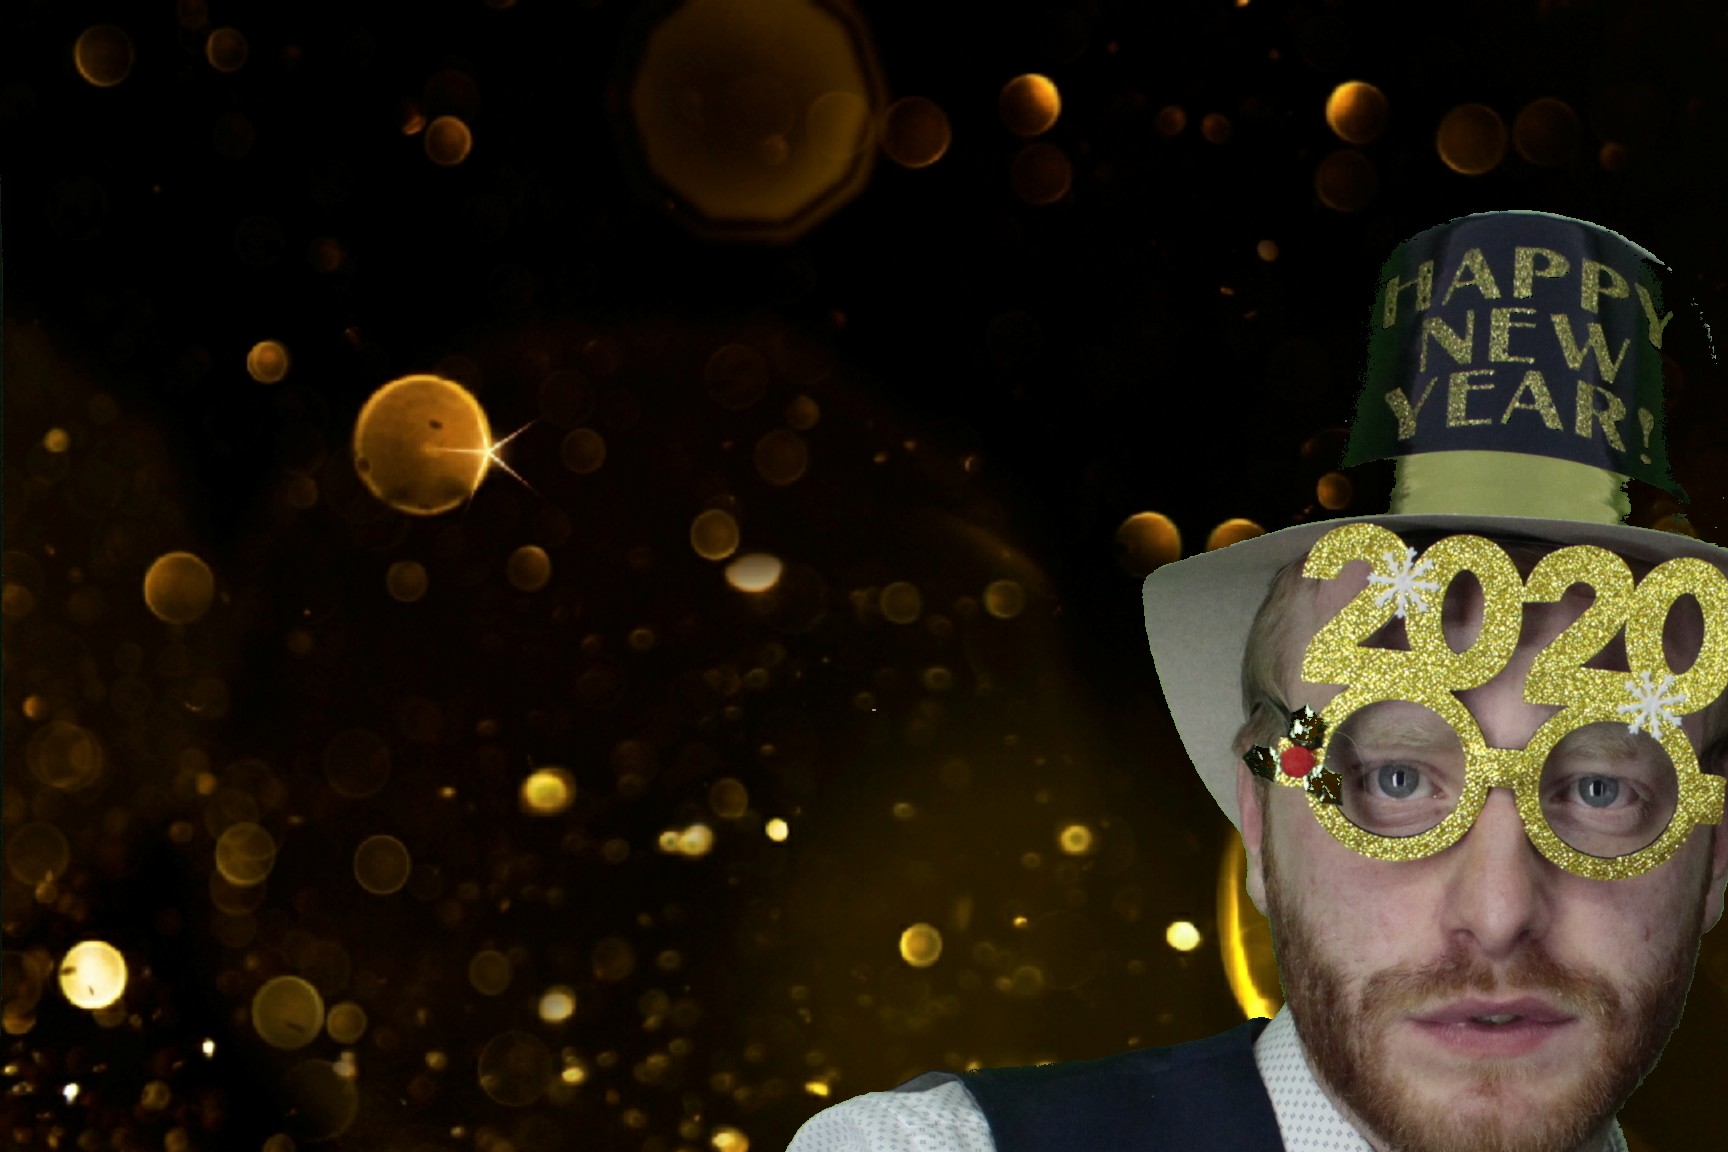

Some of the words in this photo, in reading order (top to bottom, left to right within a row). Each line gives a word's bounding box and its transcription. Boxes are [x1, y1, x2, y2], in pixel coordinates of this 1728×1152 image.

[1382, 246, 1673, 349] HAPPY
[1419, 307, 1631, 384] NEW
[1385, 369, 1656, 465] YEAR!
